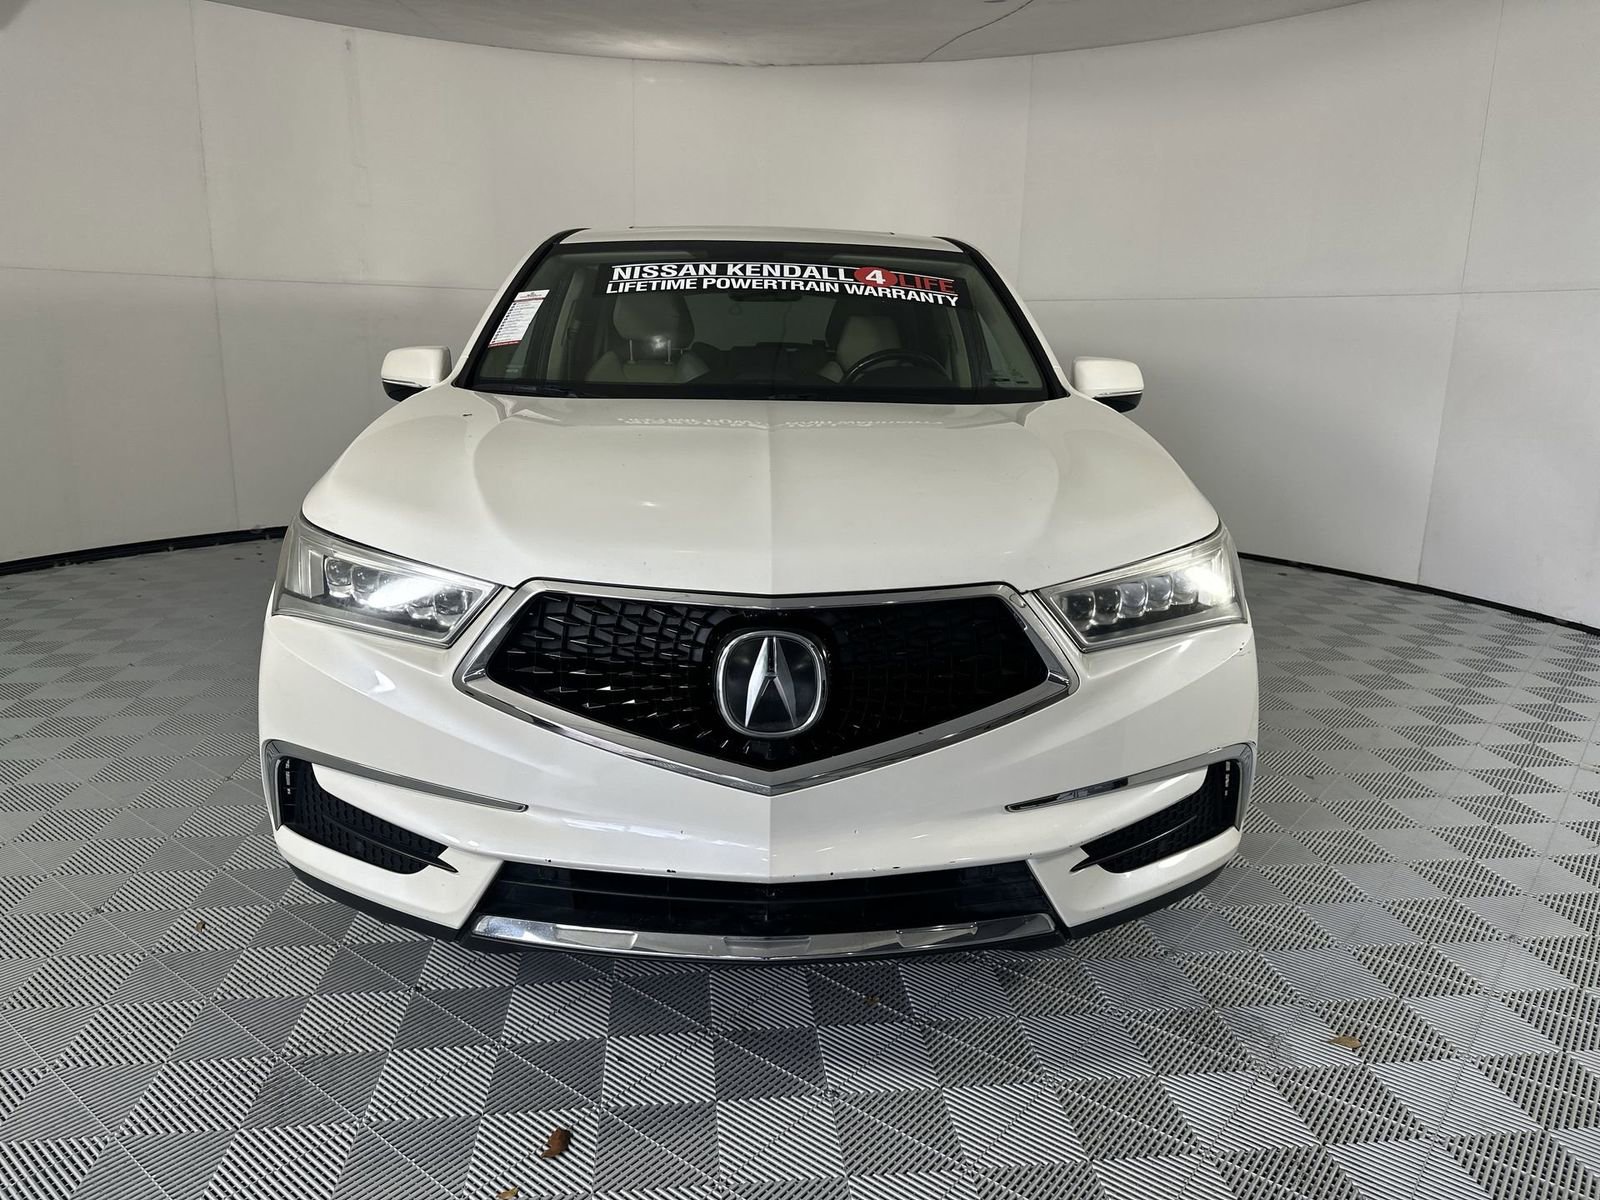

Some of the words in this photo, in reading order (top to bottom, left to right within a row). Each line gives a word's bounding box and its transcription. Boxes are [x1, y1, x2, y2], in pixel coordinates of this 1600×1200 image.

[606, 279, 697, 294] LIFETIME
[702, 278, 839, 293] POWERTRAIN
[844, 284, 958, 307] WARRANTY
[612, 264, 717, 280] NISSAN
[727, 264, 854, 282] KENDALL
[865, 269, 886, 285] 4
[898, 275, 955, 293] LIFE
